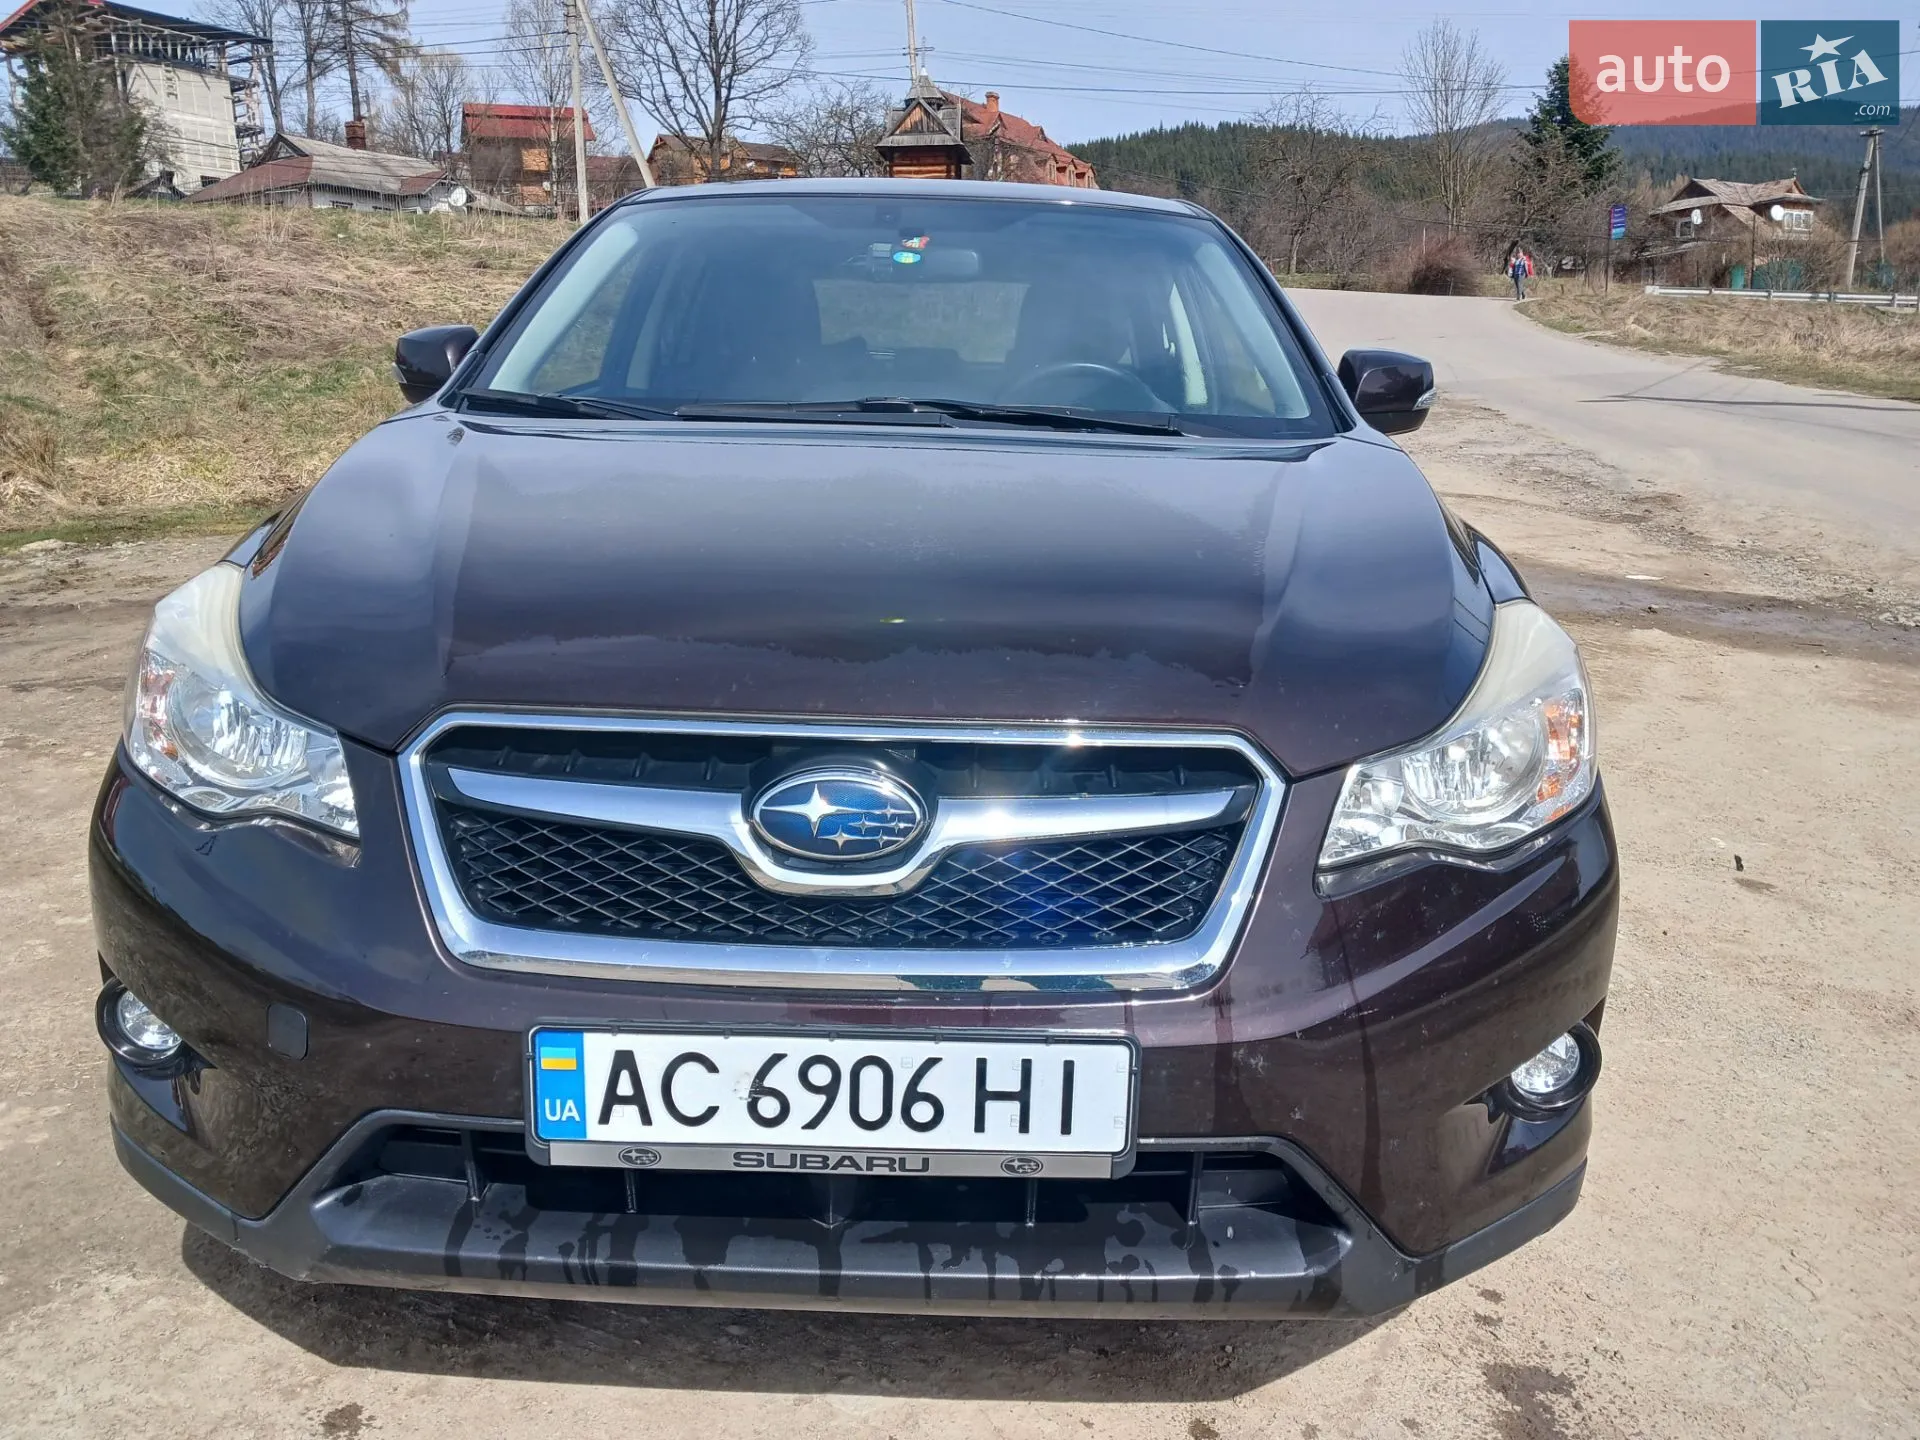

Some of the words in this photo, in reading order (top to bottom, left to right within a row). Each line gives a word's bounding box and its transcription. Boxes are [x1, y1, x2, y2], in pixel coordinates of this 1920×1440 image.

[597, 1049, 720, 1127] AC
[746, 1053, 945, 1133] 6906
[974, 1057, 1075, 1136] HI
[544, 1098, 581, 1122] UA
[732, 1150, 930, 1173] SUBARU
